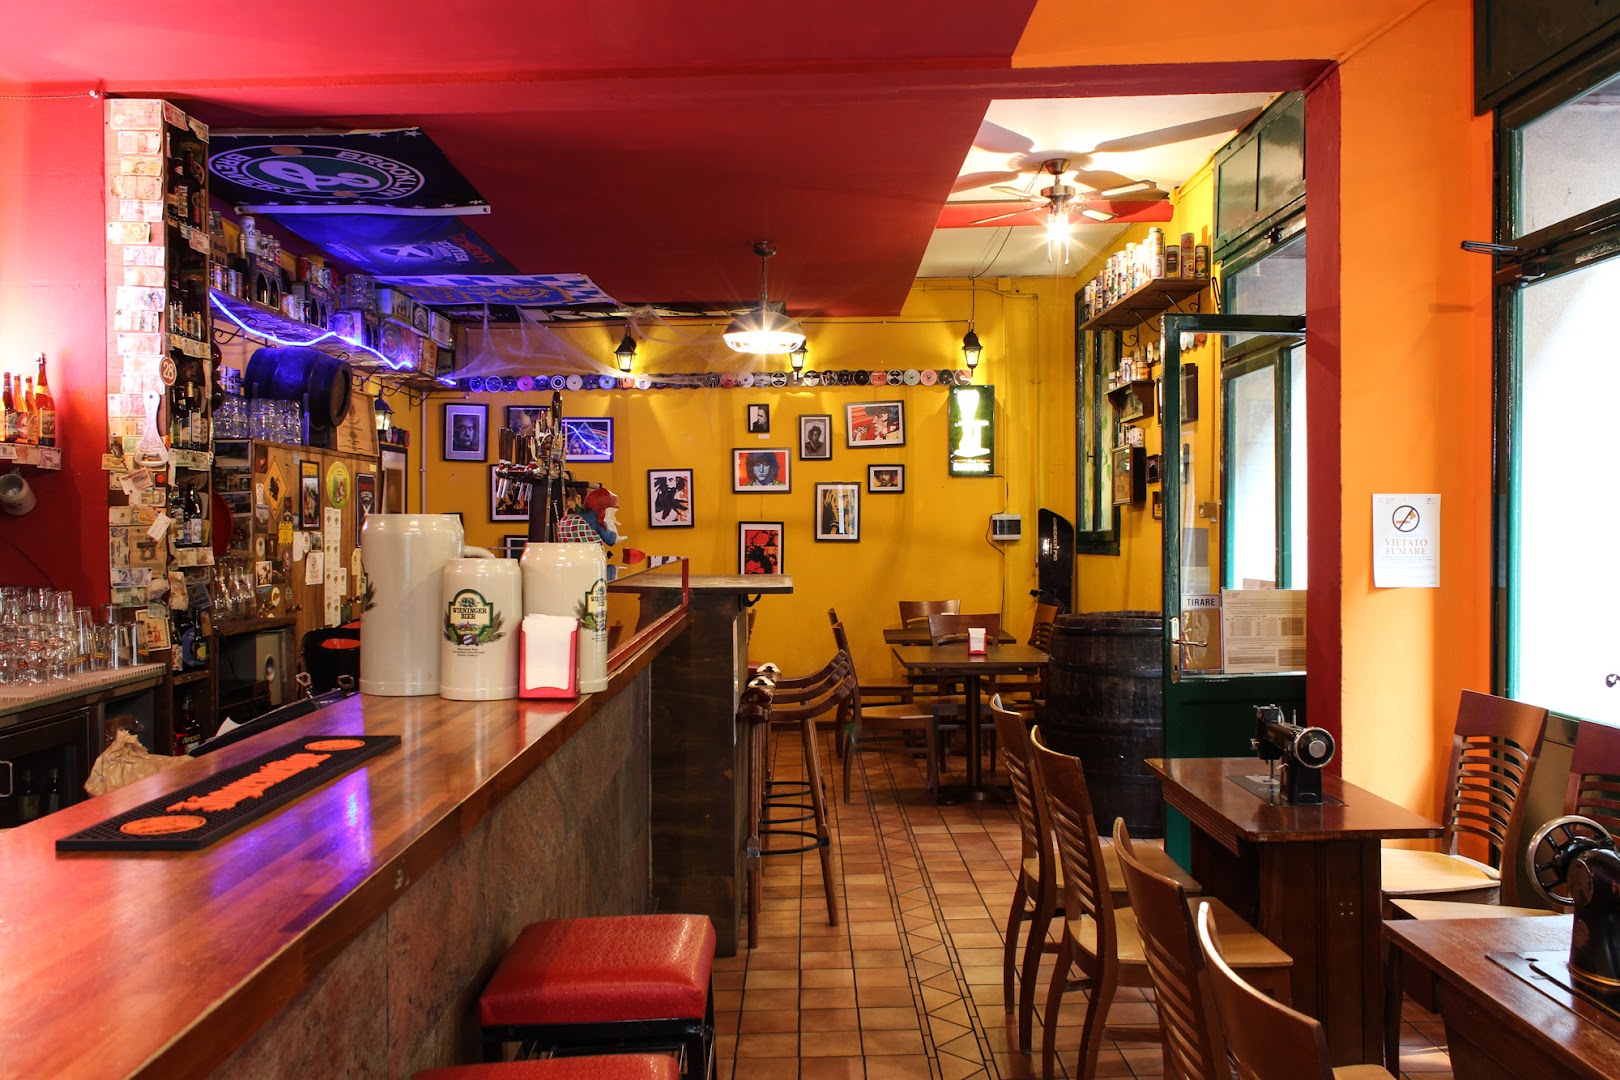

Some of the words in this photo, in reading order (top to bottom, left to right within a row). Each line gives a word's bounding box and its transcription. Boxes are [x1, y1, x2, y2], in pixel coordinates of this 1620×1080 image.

[215, 153, 298, 195] BREWERY
[335, 150, 418, 198] BROOKLYN
[162, 360, 175, 380] 28
[1385, 538, 1428, 547] VIETATO
[1386, 547, 1428, 556] FUMARE
[120, 571, 128, 582] 2
[1187, 598, 1216, 606] TIRARE
